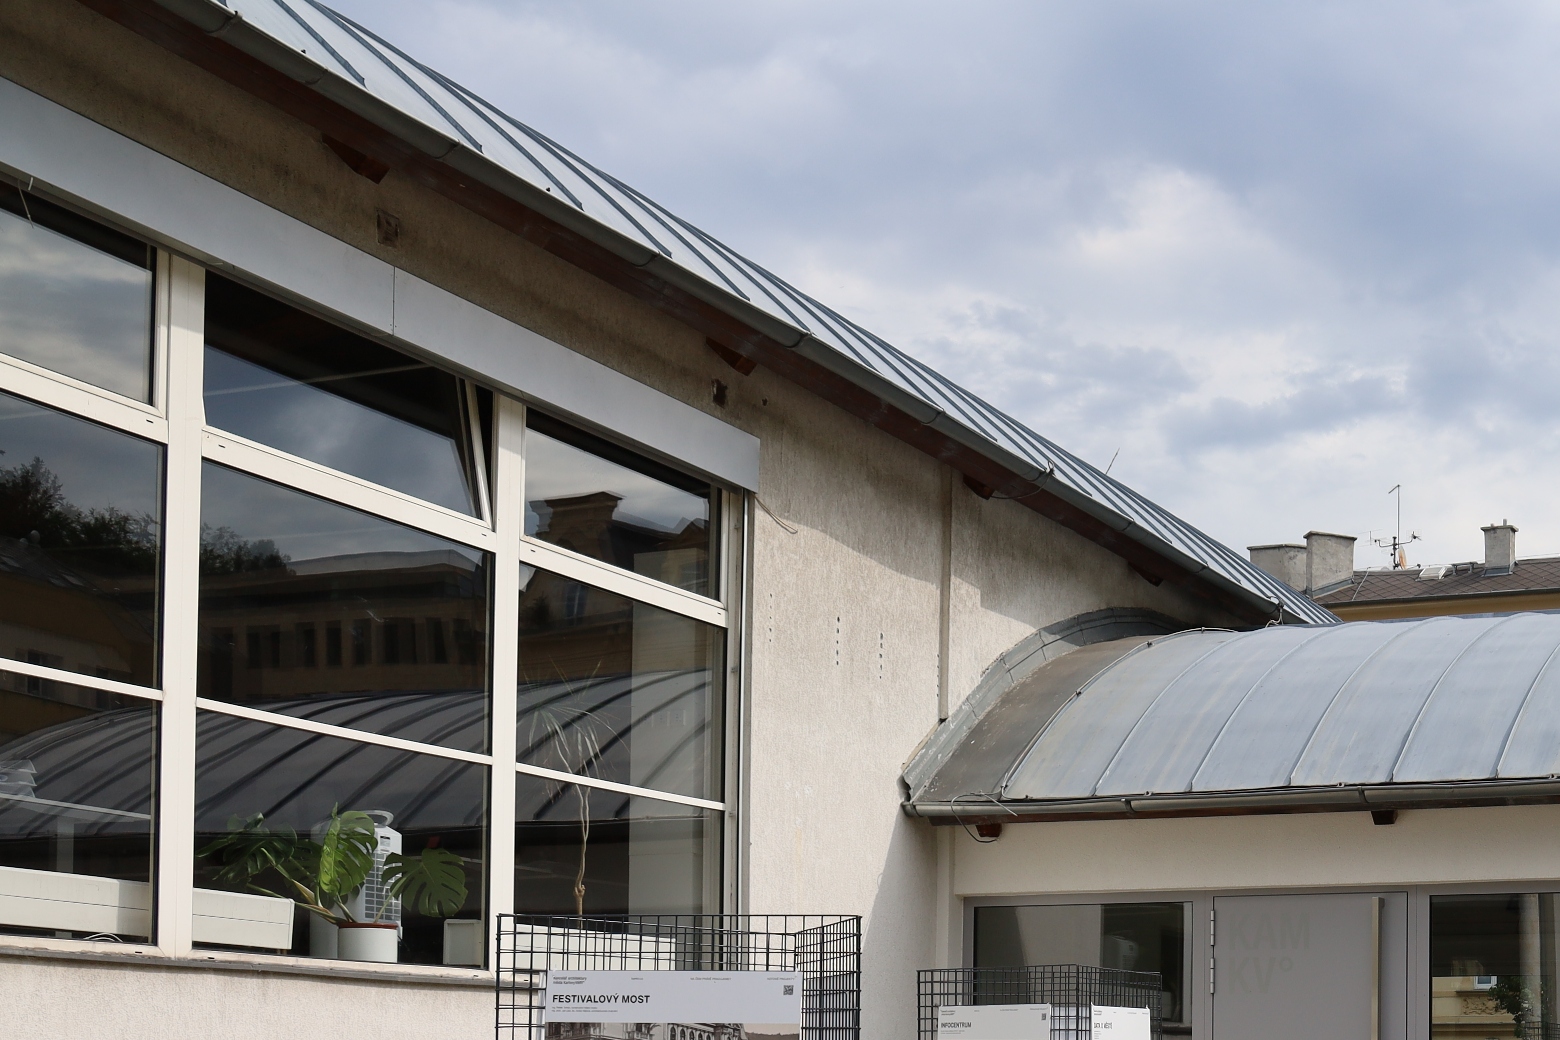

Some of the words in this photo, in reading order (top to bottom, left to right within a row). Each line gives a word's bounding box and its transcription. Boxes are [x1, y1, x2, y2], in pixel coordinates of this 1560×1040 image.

[552, 993, 619, 1004] FESTIVALOVÝ
[621, 994, 651, 1004] MOST
[941, 1021, 972, 1029] INFOCENTRUM
